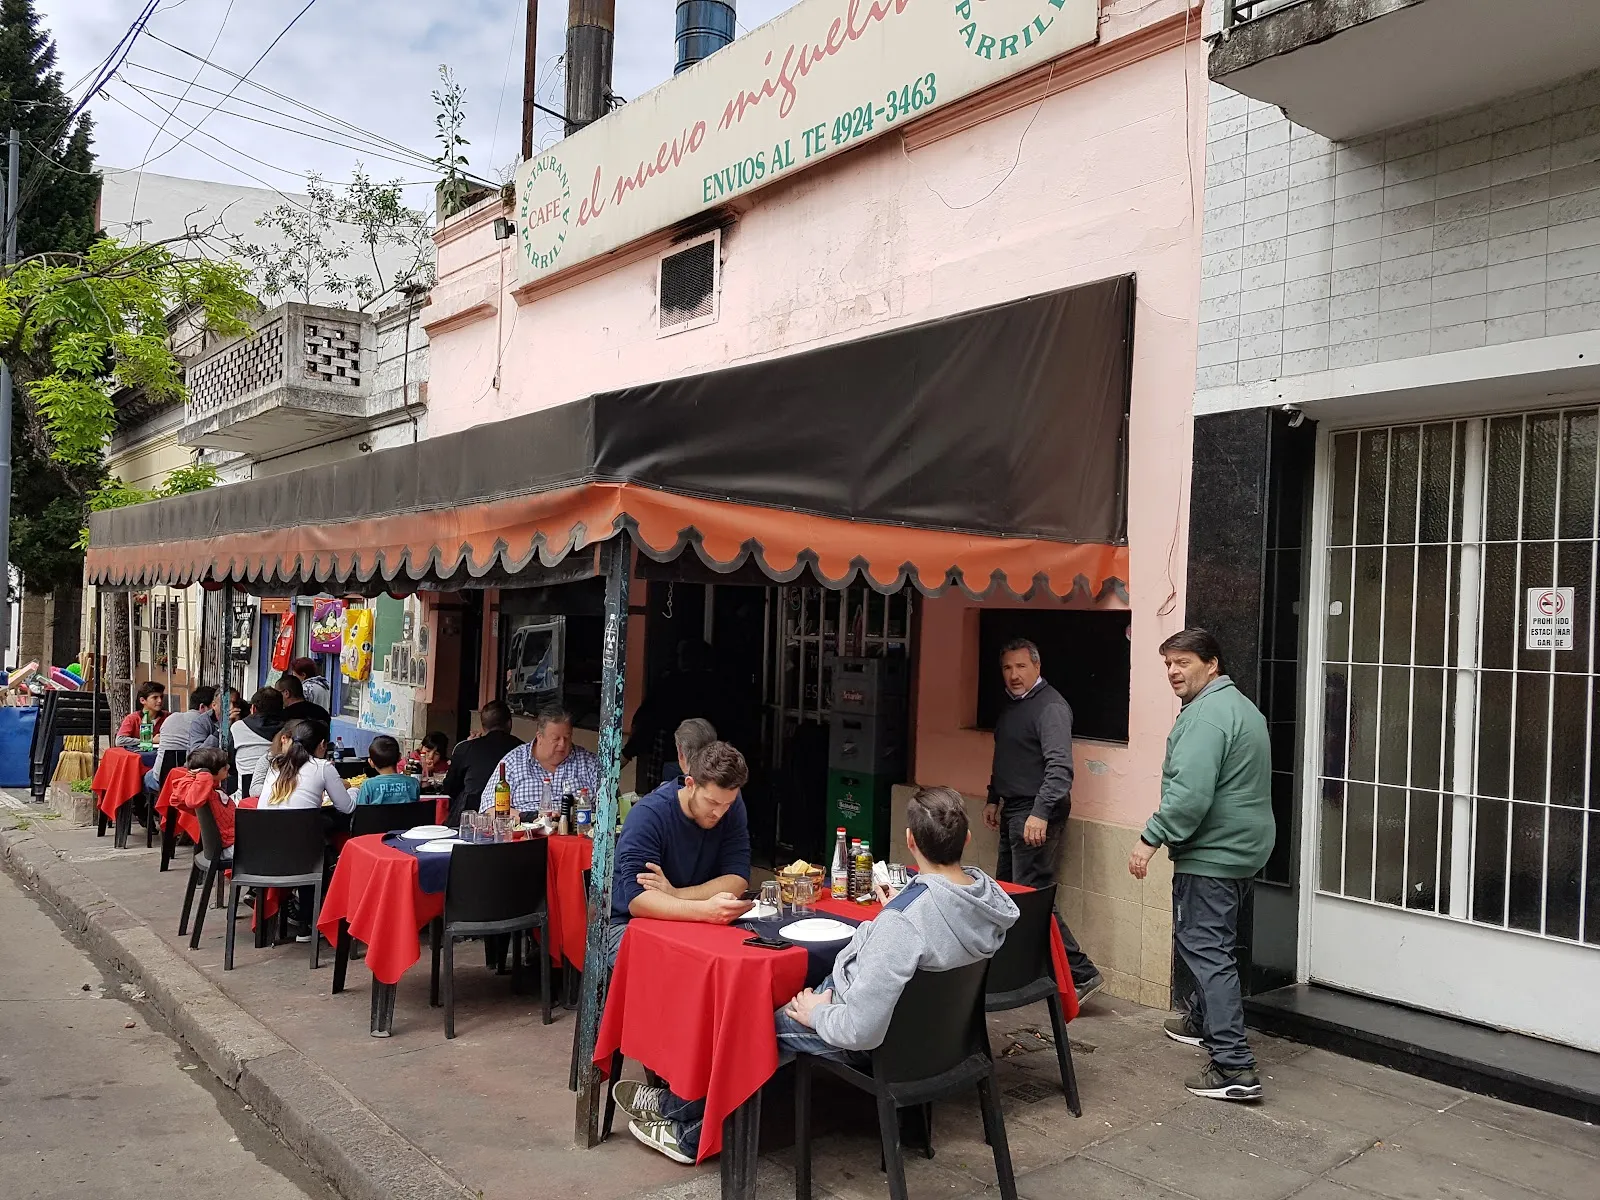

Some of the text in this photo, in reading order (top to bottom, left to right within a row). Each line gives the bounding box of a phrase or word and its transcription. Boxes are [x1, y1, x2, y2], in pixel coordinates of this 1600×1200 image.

[702, 72, 937, 203] ENVIOS AL TE 4924-3463
[521, 156, 571, 218] RESTAURANT
[576, 165, 606, 228] el
[610, 120, 706, 206] nuevo
[528, 198, 561, 230] CAFE
[522, 207, 571, 269] PARRILLA
[1531, 628, 1571, 636] ESTACINAR
[1532, 617, 1570, 625] PROHIIDO
[1537, 639, 1564, 647] GARGE
